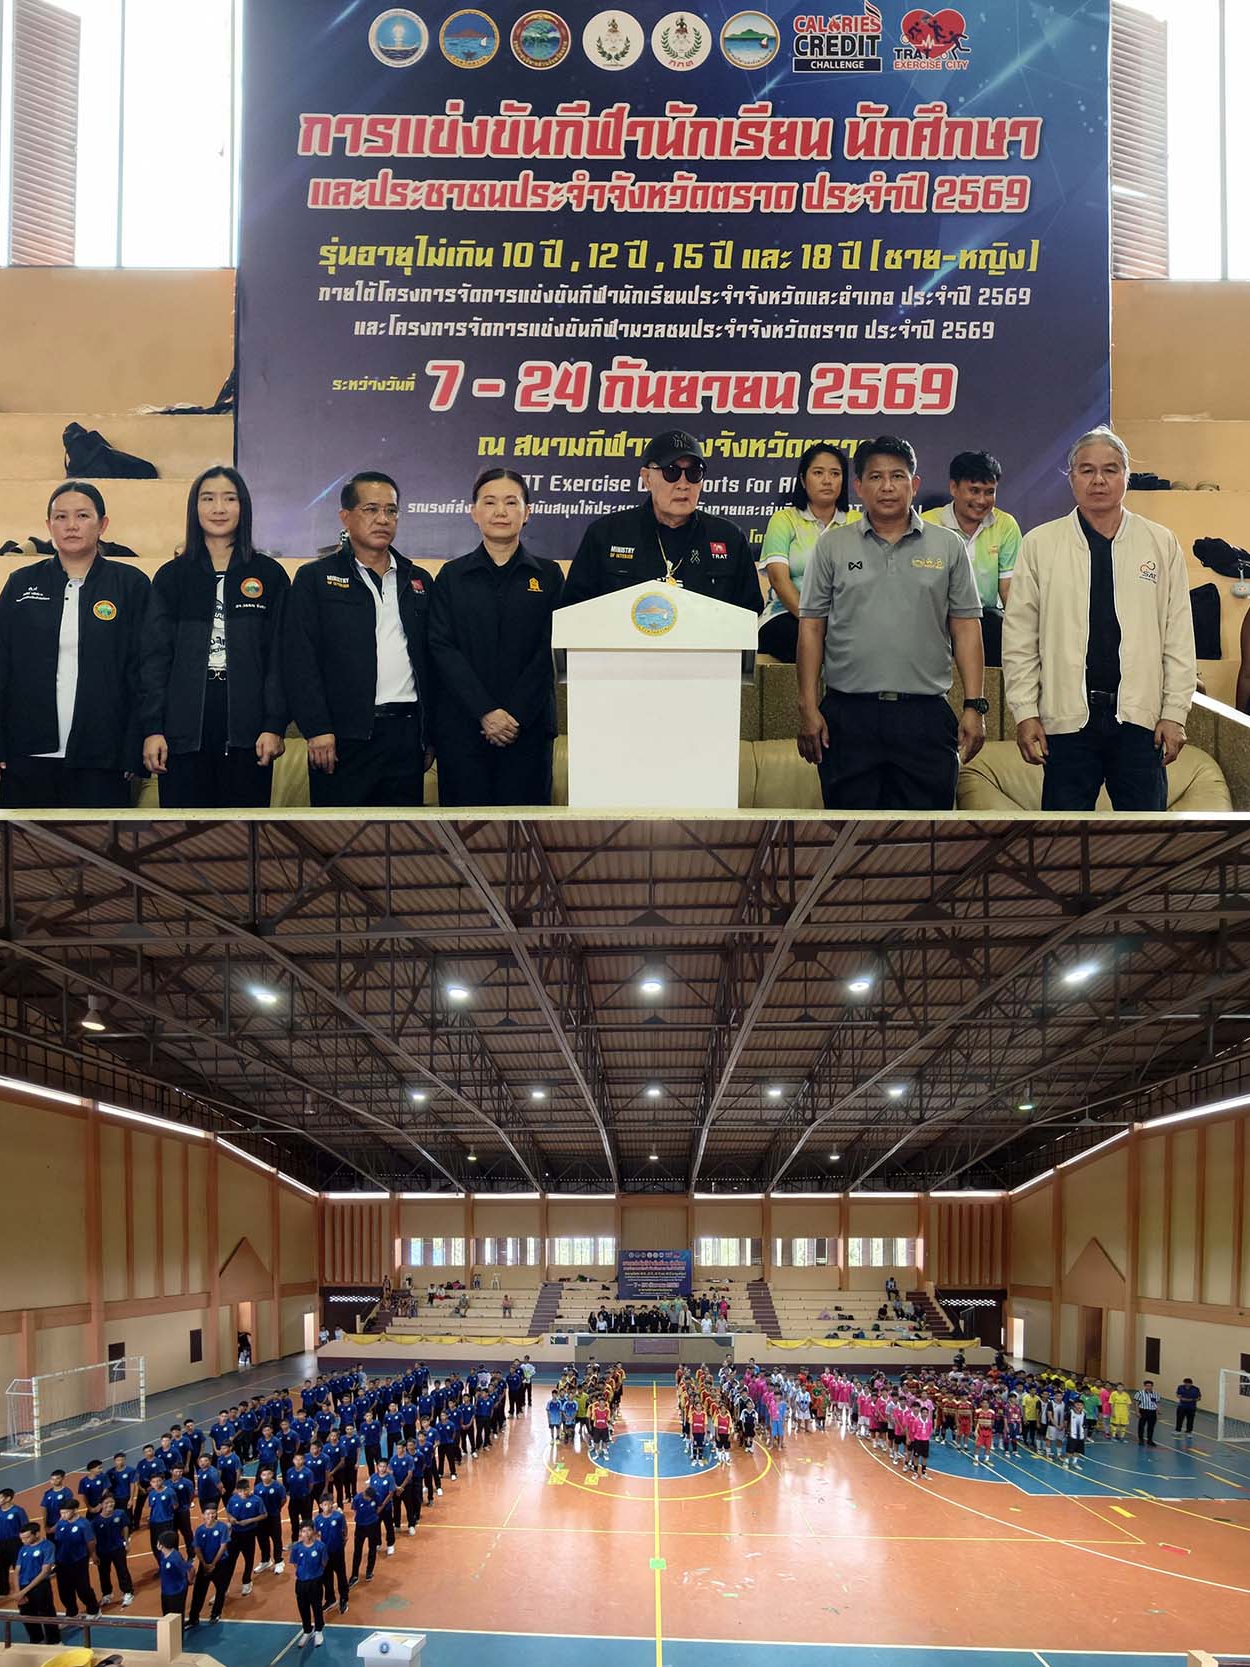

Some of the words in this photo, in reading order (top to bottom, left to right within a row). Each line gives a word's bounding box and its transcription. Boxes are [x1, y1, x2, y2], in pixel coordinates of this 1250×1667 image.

[793, 15, 882, 33] CALORIES
[794, 34, 881, 57] CREDIT
[894, 48, 932, 60] TRAT
[810, 60, 865, 69] CHALLENGE
[894, 60, 942, 70] EXERCISE
[945, 60, 969, 70] CITY
[298, 99, 833, 160] การแข่งขันกีฬานักเรียน
[844, 101, 1042, 160] นักศึกษา
[308, 169, 799, 213] และประชาชนประจำจังหวัดตราด
[802, 171, 929, 213] ประจำปี
[932, 176, 1031, 213] 2569
[318, 235, 494, 275] รุ่นอายุไม่เกิน
[502, 242, 534, 267] 10
[539, 239, 564, 268] ปี
[588, 243, 618, 268] 12
[624, 240, 649, 269] ปี
[673, 243, 704, 269] 15
[709, 240, 734, 269] ปี
[741, 248, 792, 269] และ
[801, 243, 832, 269] 18
[838, 240, 862, 270] ปี
[901, 285, 971, 306] ประจำปี
[978, 287, 1031, 306] 2569
[865, 319, 934, 339] ประจำปี
[941, 321, 995, 339] 2569
[332, 373, 417, 391] ระหว่างวันที่
[425, 359, 465, 412] 7
[514, 360, 592, 413] 24
[598, 355, 801, 414] กันยายน
[807, 362, 959, 415] 2569
[477, 435, 505, 456] ณ
[550, 475, 631, 492] Exercise
